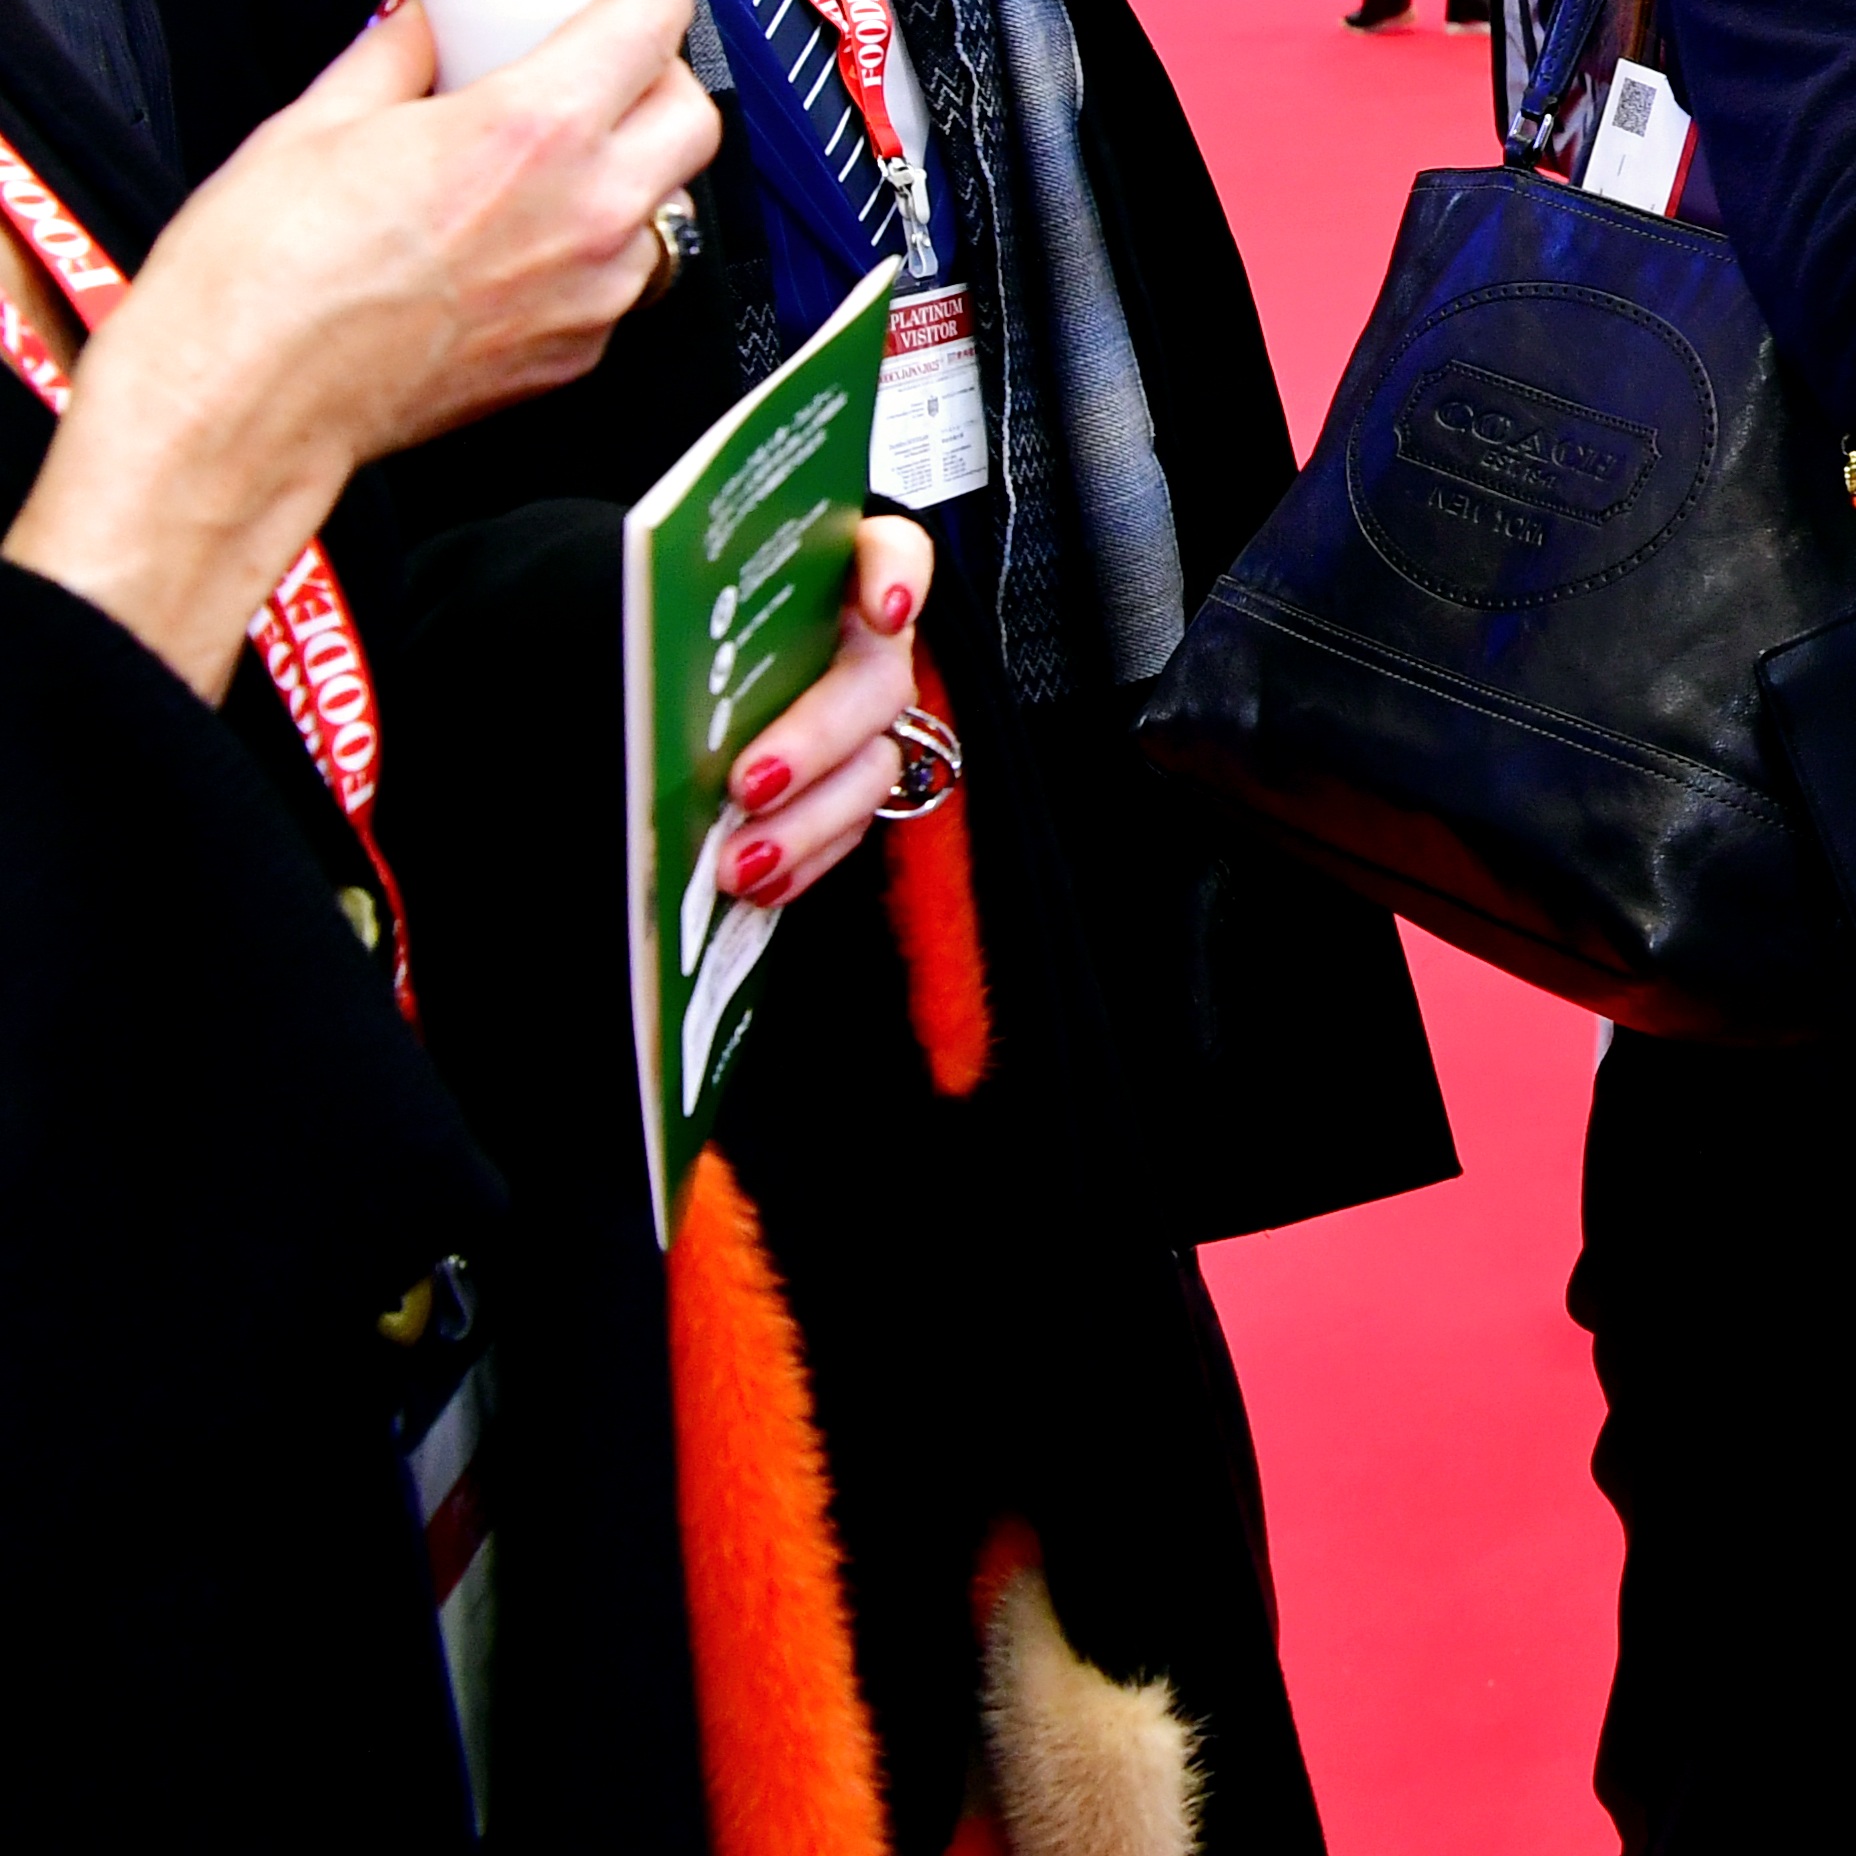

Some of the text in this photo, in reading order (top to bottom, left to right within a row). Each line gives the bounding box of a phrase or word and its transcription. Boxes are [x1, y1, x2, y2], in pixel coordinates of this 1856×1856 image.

[889, 297, 964, 332] PLATINUM
[900, 320, 958, 349] VISITOR
[275, 547, 377, 815] FOODEX
